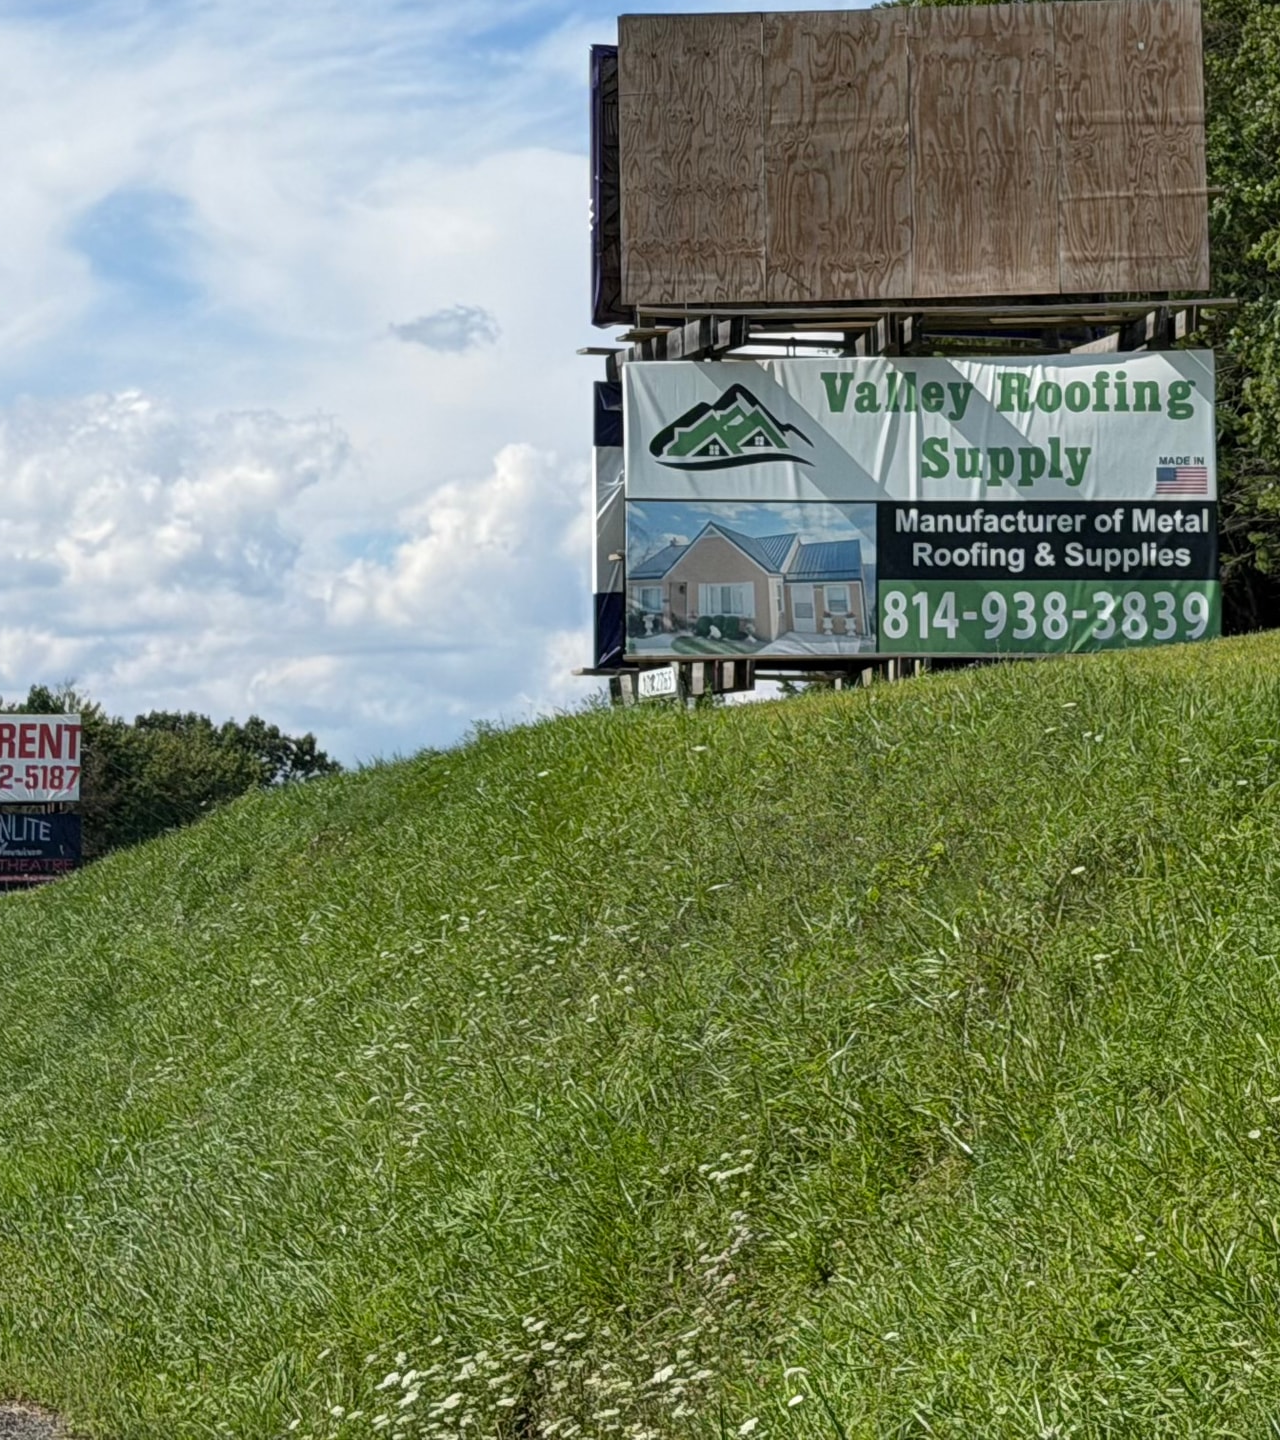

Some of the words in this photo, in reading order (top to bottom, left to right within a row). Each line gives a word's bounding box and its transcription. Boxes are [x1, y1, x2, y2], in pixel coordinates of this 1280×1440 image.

[820, 371, 974, 421] Valley
[995, 370, 1197, 420] Roofing
[920, 435, 1092, 487] Supply
[1158, 455, 1191, 466] MADE
[1193, 456, 1205, 466] IN
[894, 508, 1087, 534] Manufacturer
[1094, 507, 1125, 533] of
[1131, 507, 1210, 533] Metal
[912, 541, 1026, 573] Roofing
[1034, 542, 1057, 567] &
[1064, 541, 1192, 573] Supplies
[882, 589, 1211, 641] 814-938-3839
[0, 859, 74, 873] THEATRE
